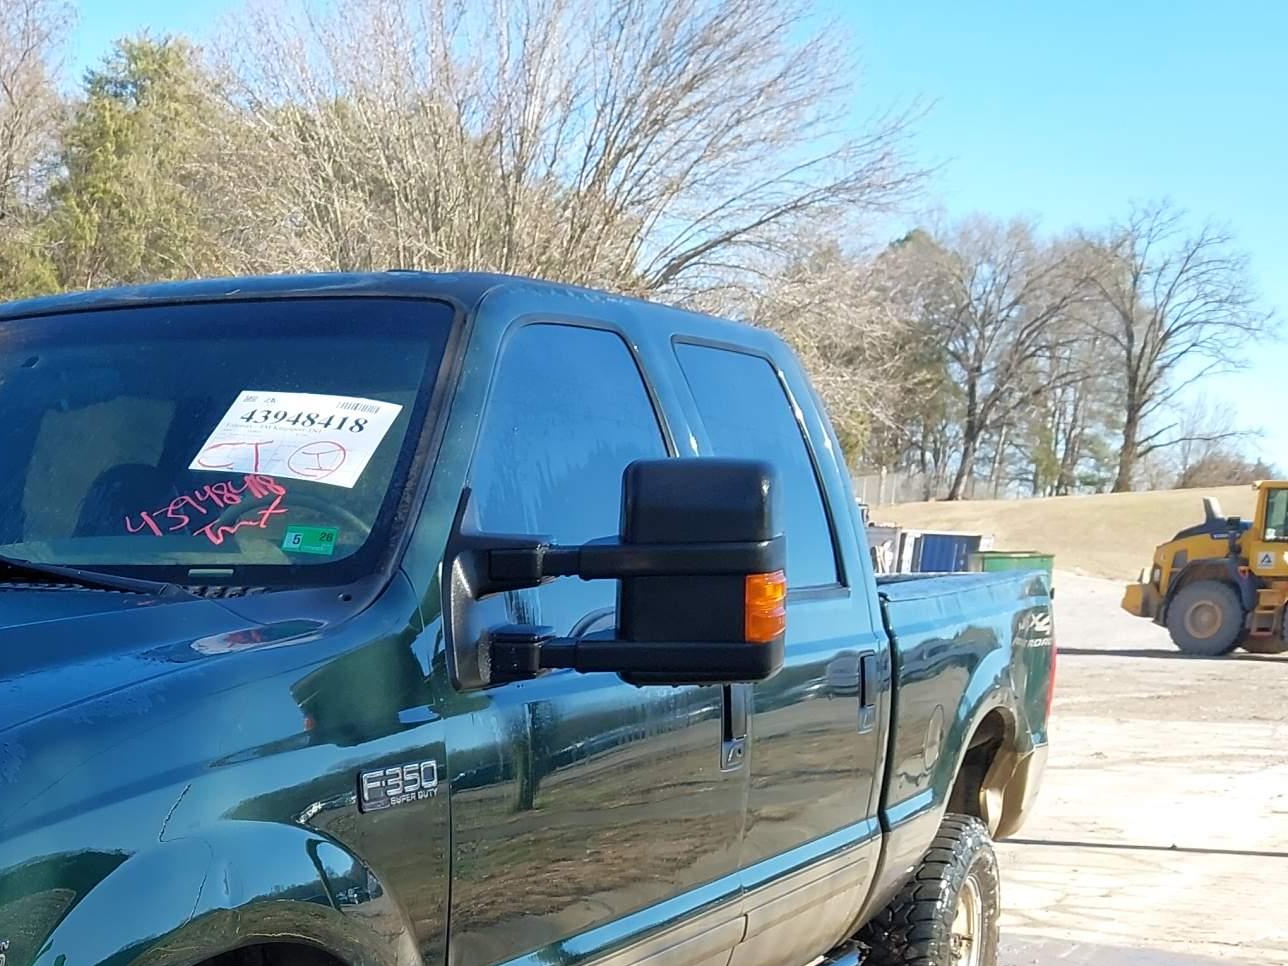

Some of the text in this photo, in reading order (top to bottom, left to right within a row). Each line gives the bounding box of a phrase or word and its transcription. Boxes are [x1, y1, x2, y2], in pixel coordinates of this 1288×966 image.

[240, 408, 368, 433] 43948418
[390, 787, 439, 806] SUPER DUTY
